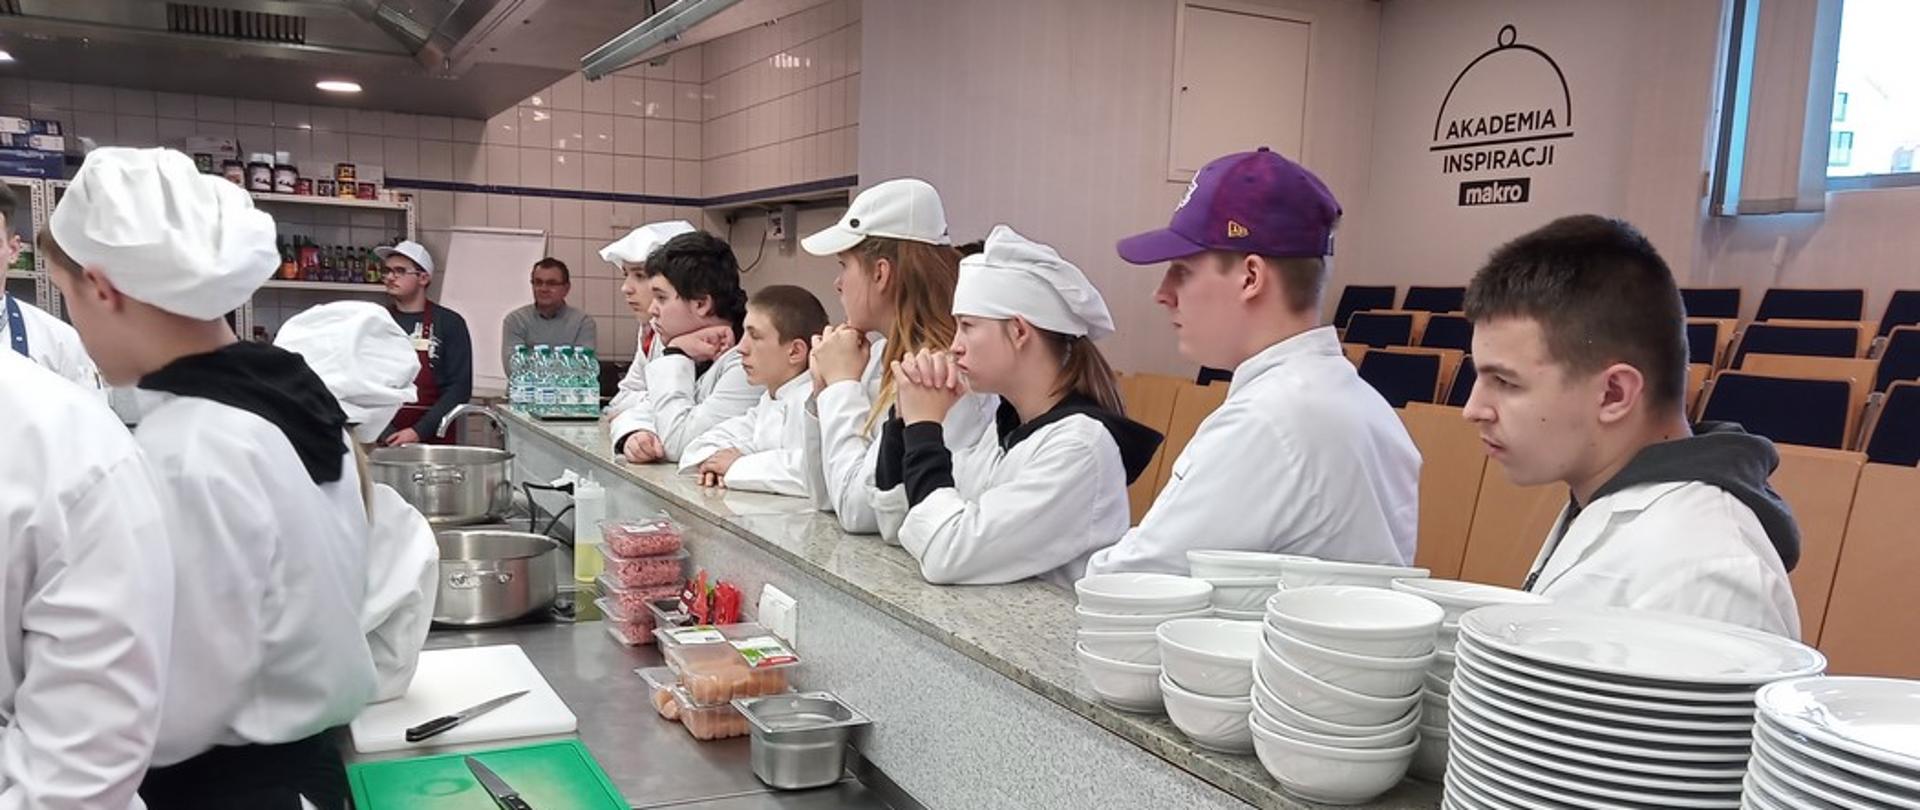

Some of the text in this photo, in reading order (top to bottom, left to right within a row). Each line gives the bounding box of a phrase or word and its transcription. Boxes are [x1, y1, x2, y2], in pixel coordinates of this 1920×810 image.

[1446, 108, 1556, 139] AKADEMIA
[1443, 145, 1554, 173] INSPIRACJI
[1465, 181, 1522, 204] makro
